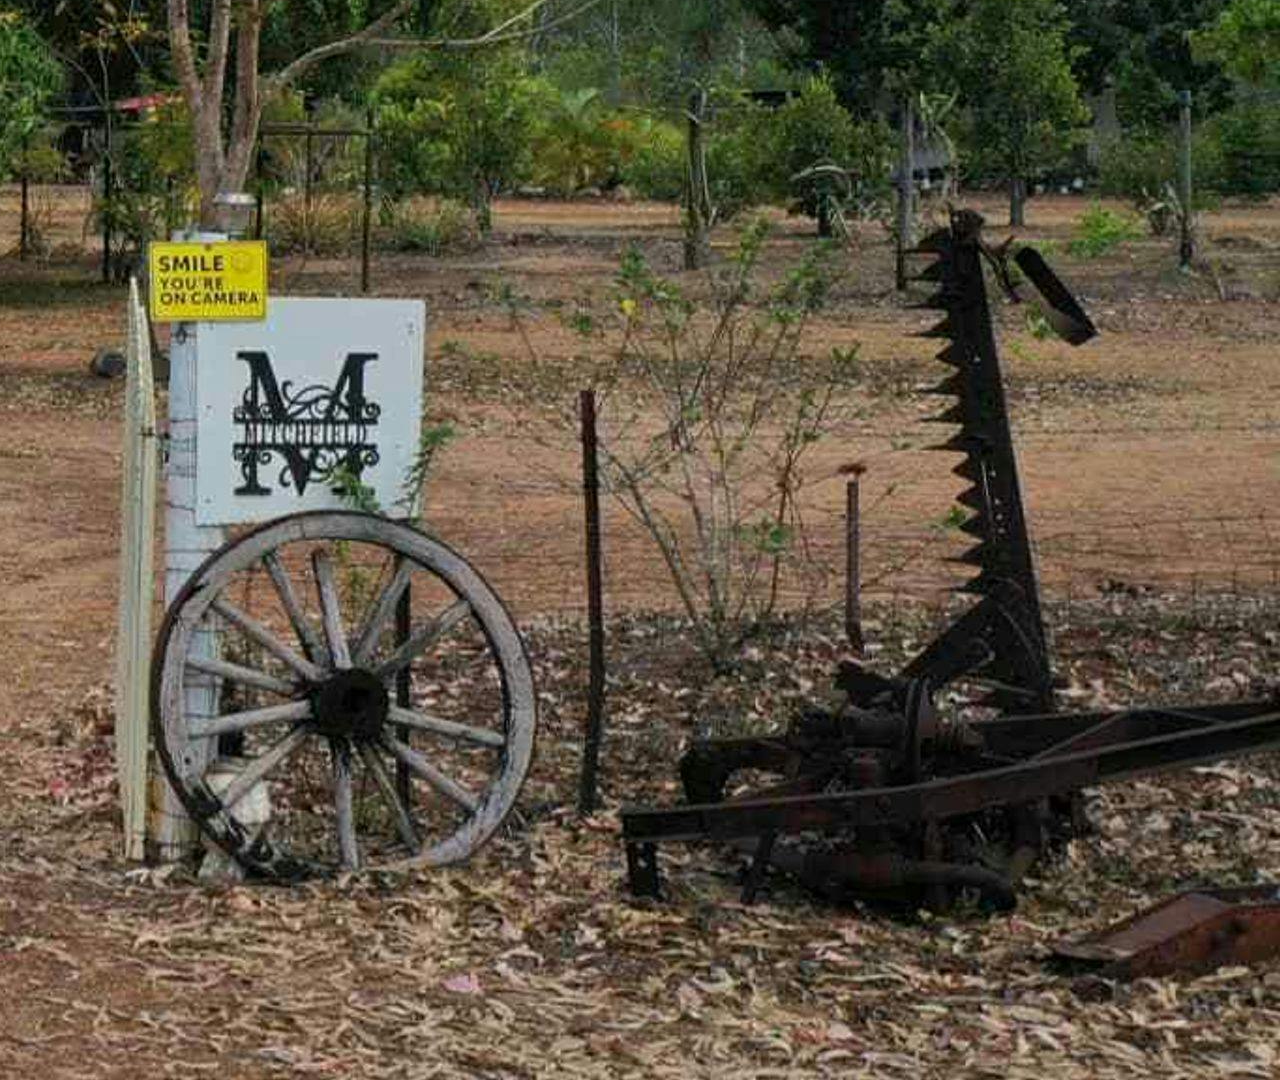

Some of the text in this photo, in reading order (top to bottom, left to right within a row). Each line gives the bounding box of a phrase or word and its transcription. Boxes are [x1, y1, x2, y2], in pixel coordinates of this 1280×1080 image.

[158, 254, 224, 271] SMILE
[160, 291, 259, 305] ON CAMERA
